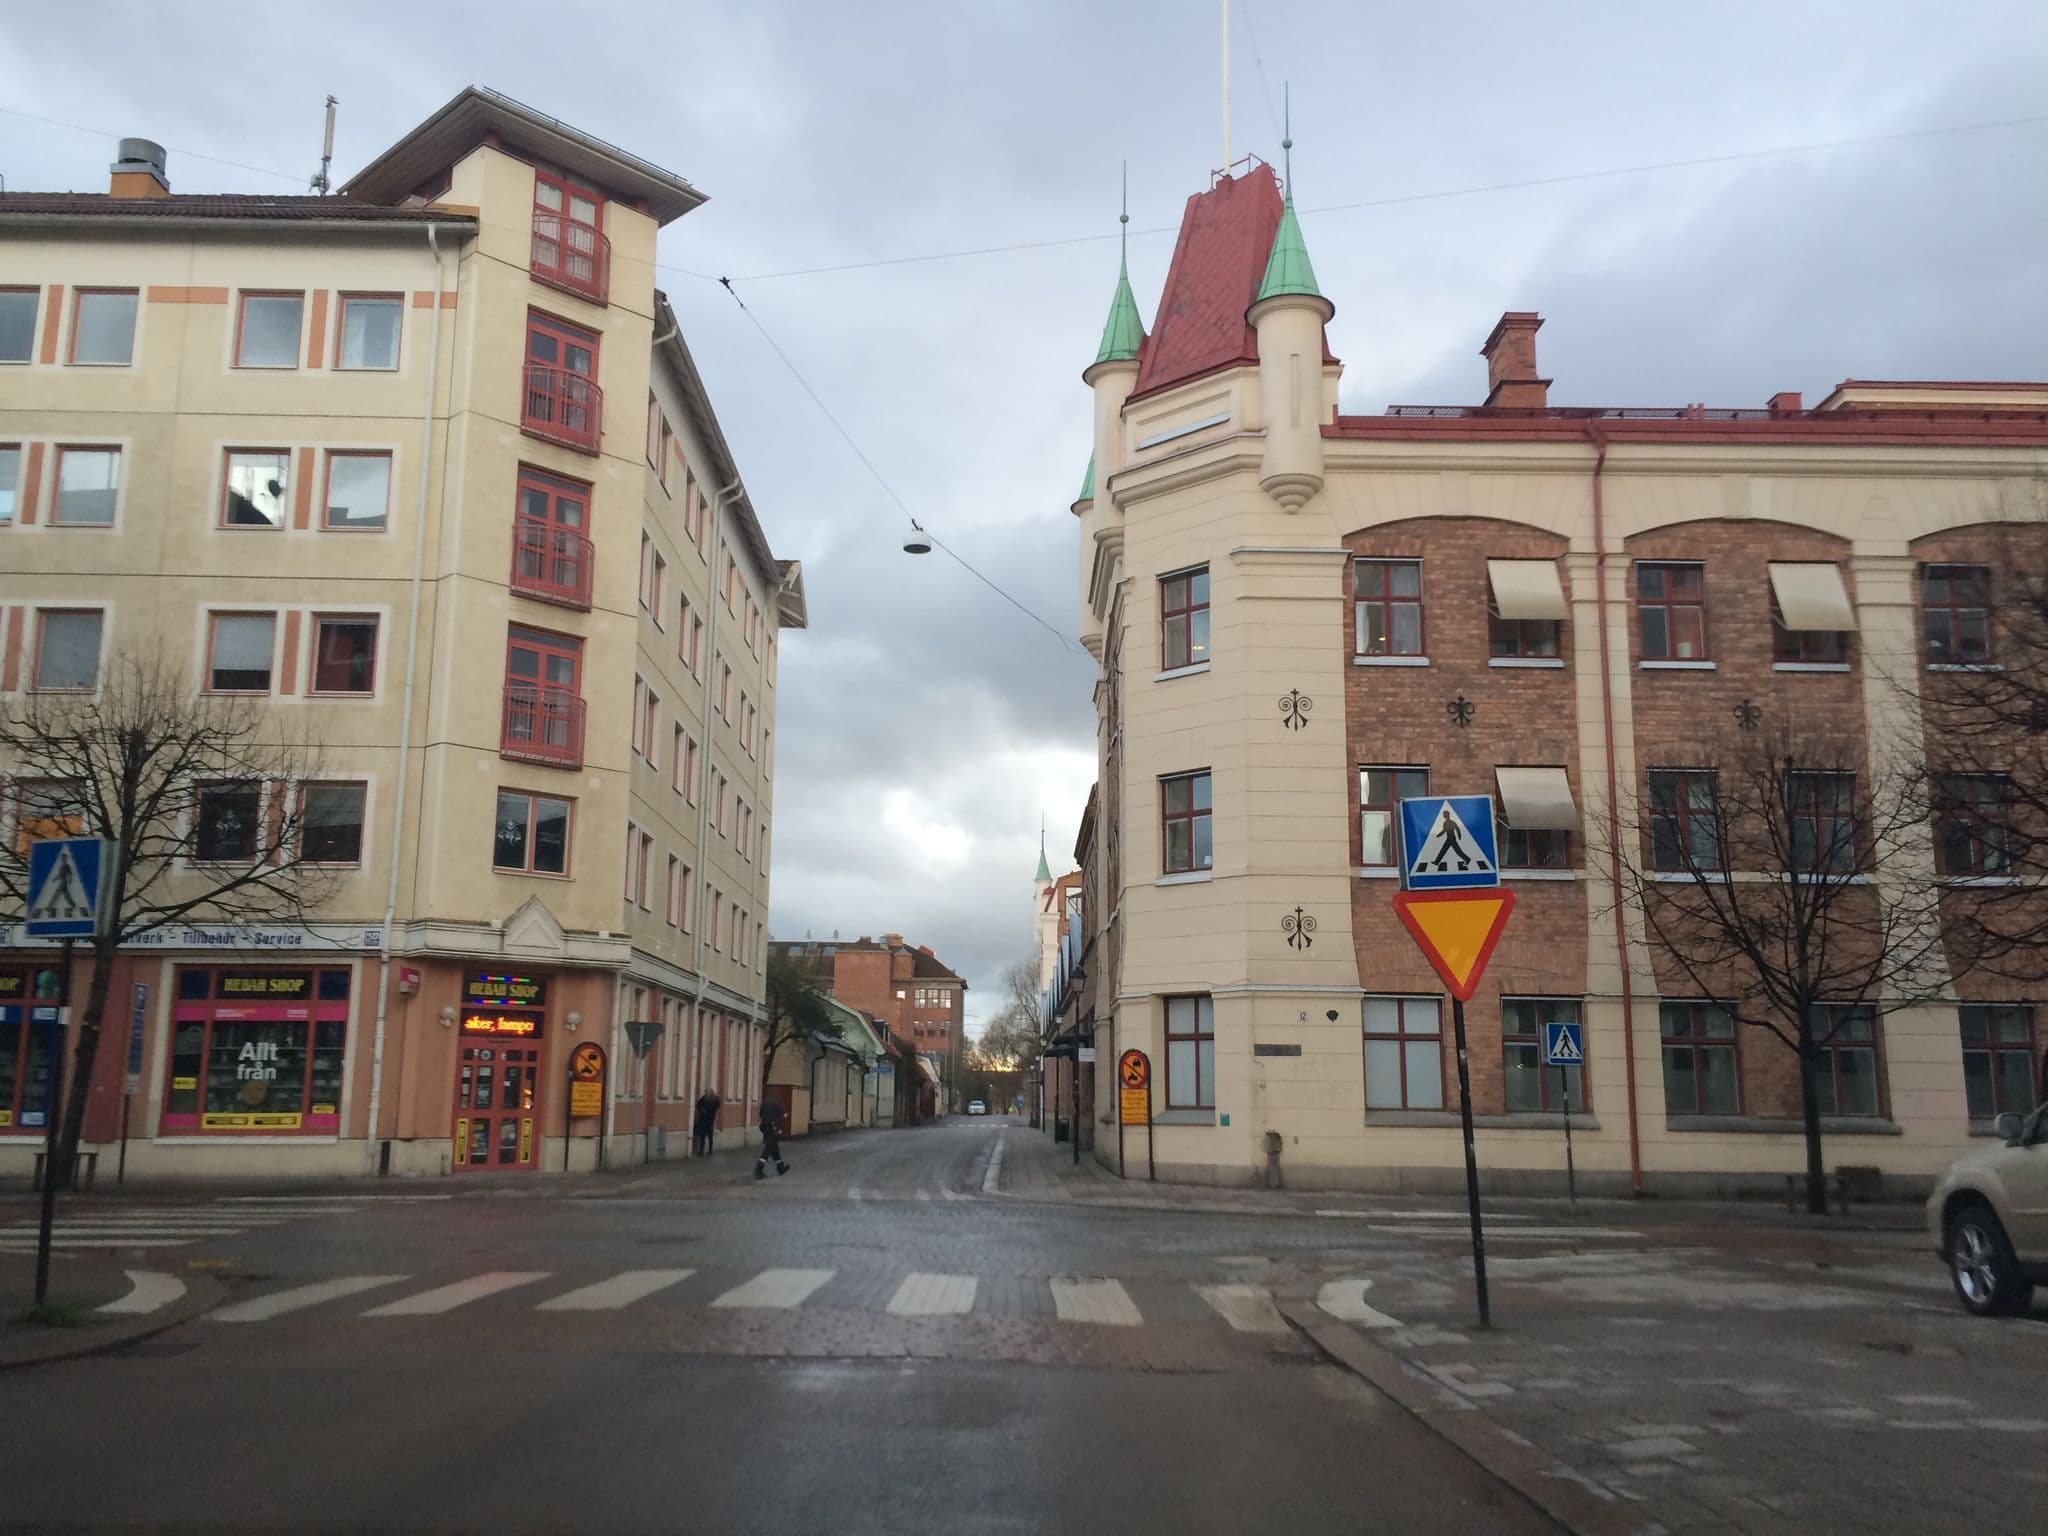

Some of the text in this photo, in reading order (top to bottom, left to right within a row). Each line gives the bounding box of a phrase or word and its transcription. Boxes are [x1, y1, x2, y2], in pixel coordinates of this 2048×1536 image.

[255, 931, 302, 945] Service
[269, 978, 305, 992] SHOP
[508, 984, 540, 998] SHOP
[1299, 1011, 1307, 1021] 12
[238, 1041, 279, 1061] Allt
[236, 1061, 277, 1080] från
